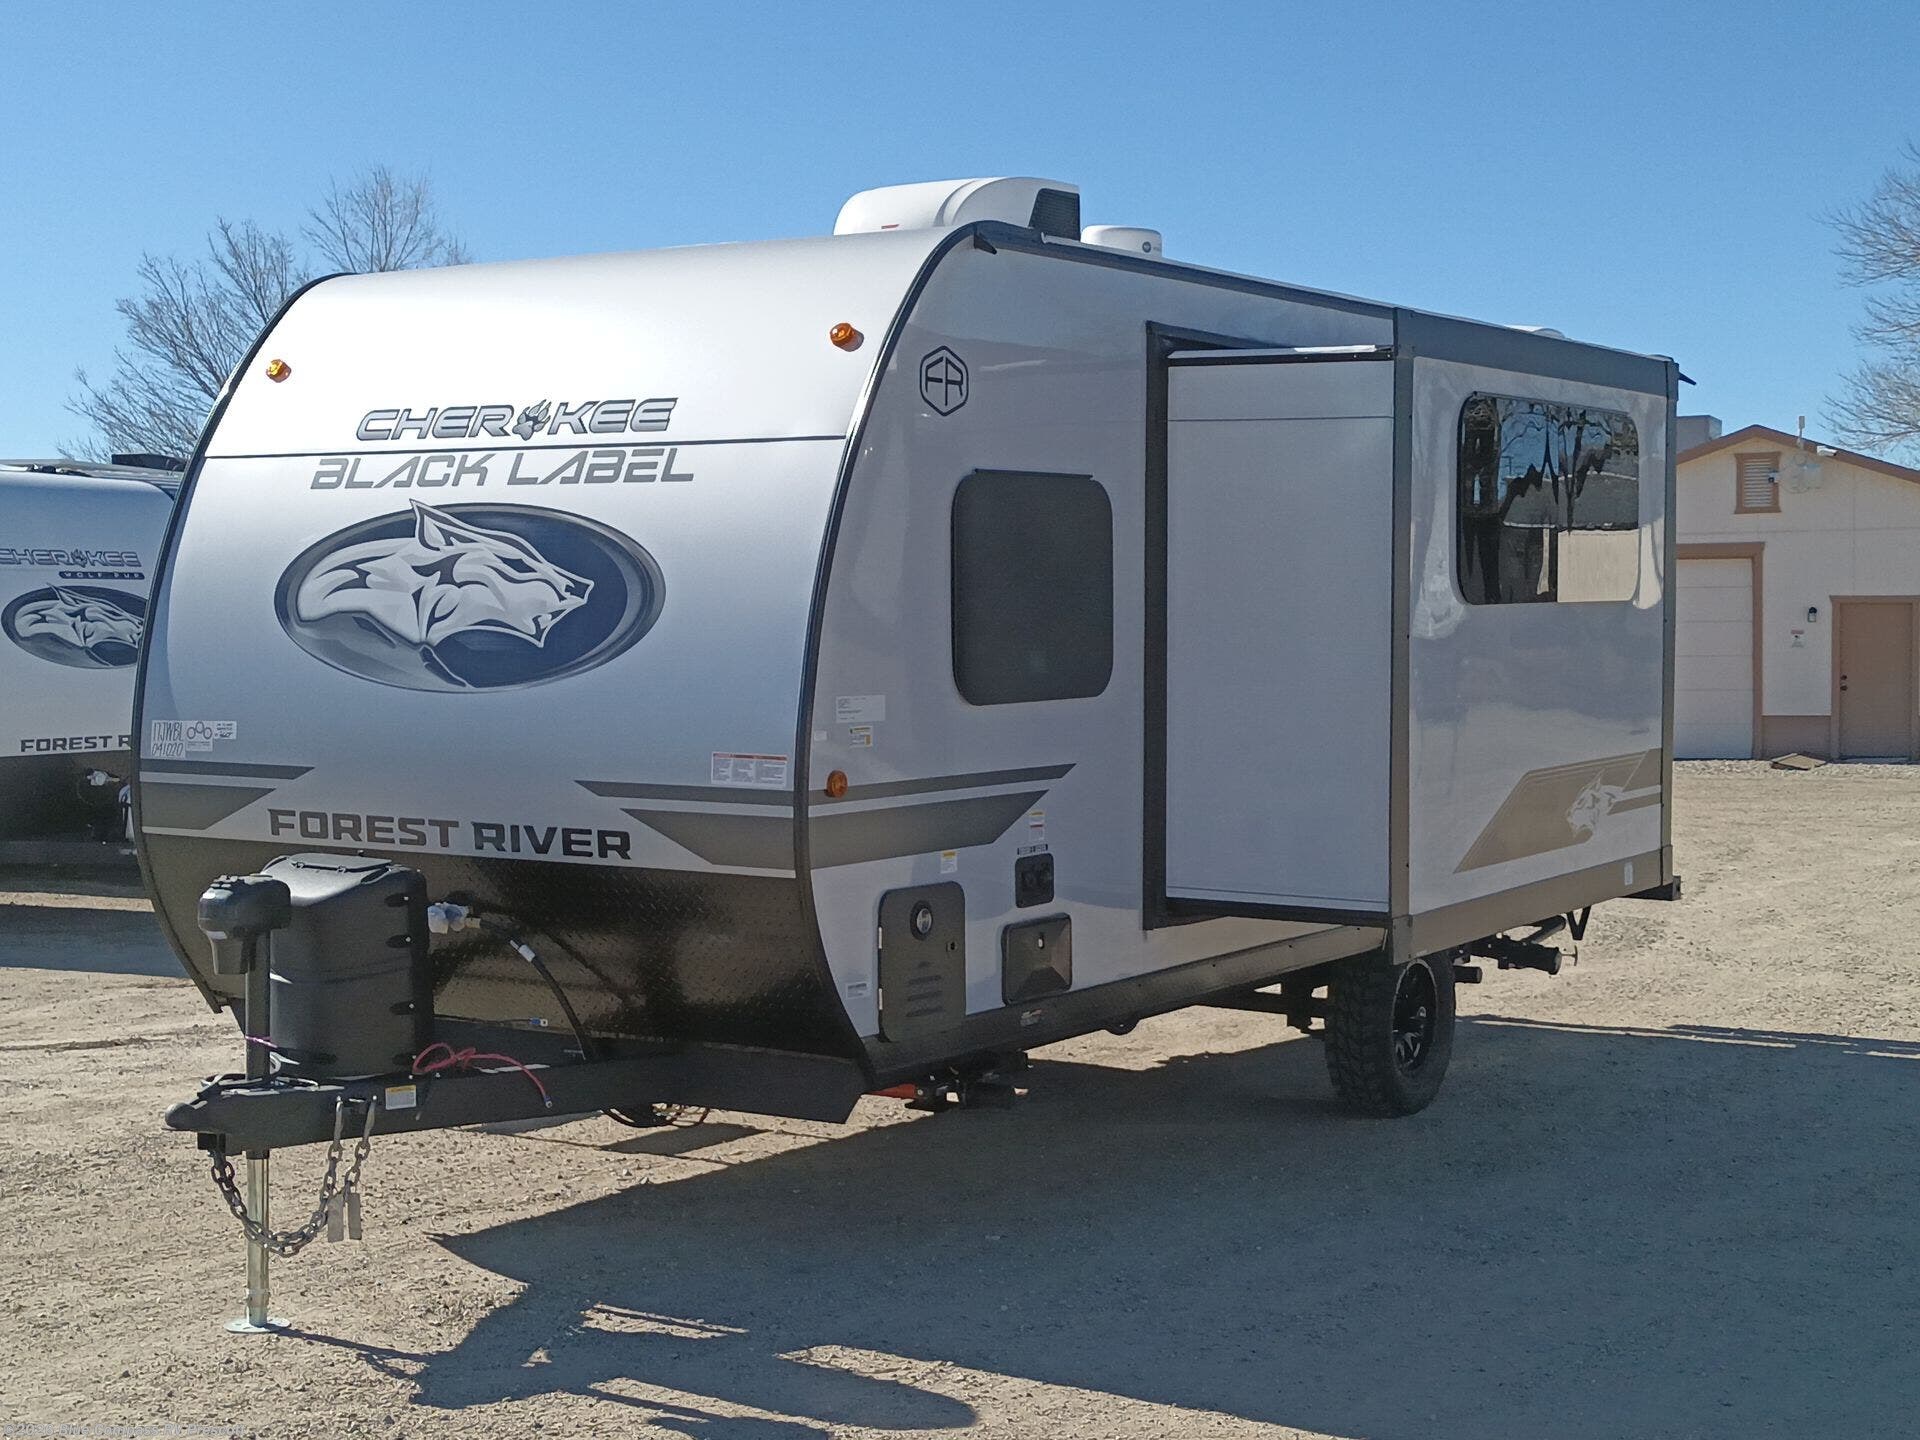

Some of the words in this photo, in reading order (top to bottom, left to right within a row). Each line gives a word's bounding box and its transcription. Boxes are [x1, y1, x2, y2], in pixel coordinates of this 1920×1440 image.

[310, 453, 496, 489] BLACK
[507, 448, 694, 485] LABEL
[20, 735, 113, 752] FOREST
[267, 808, 459, 848] FOREST
[470, 820, 632, 860] RIVER
